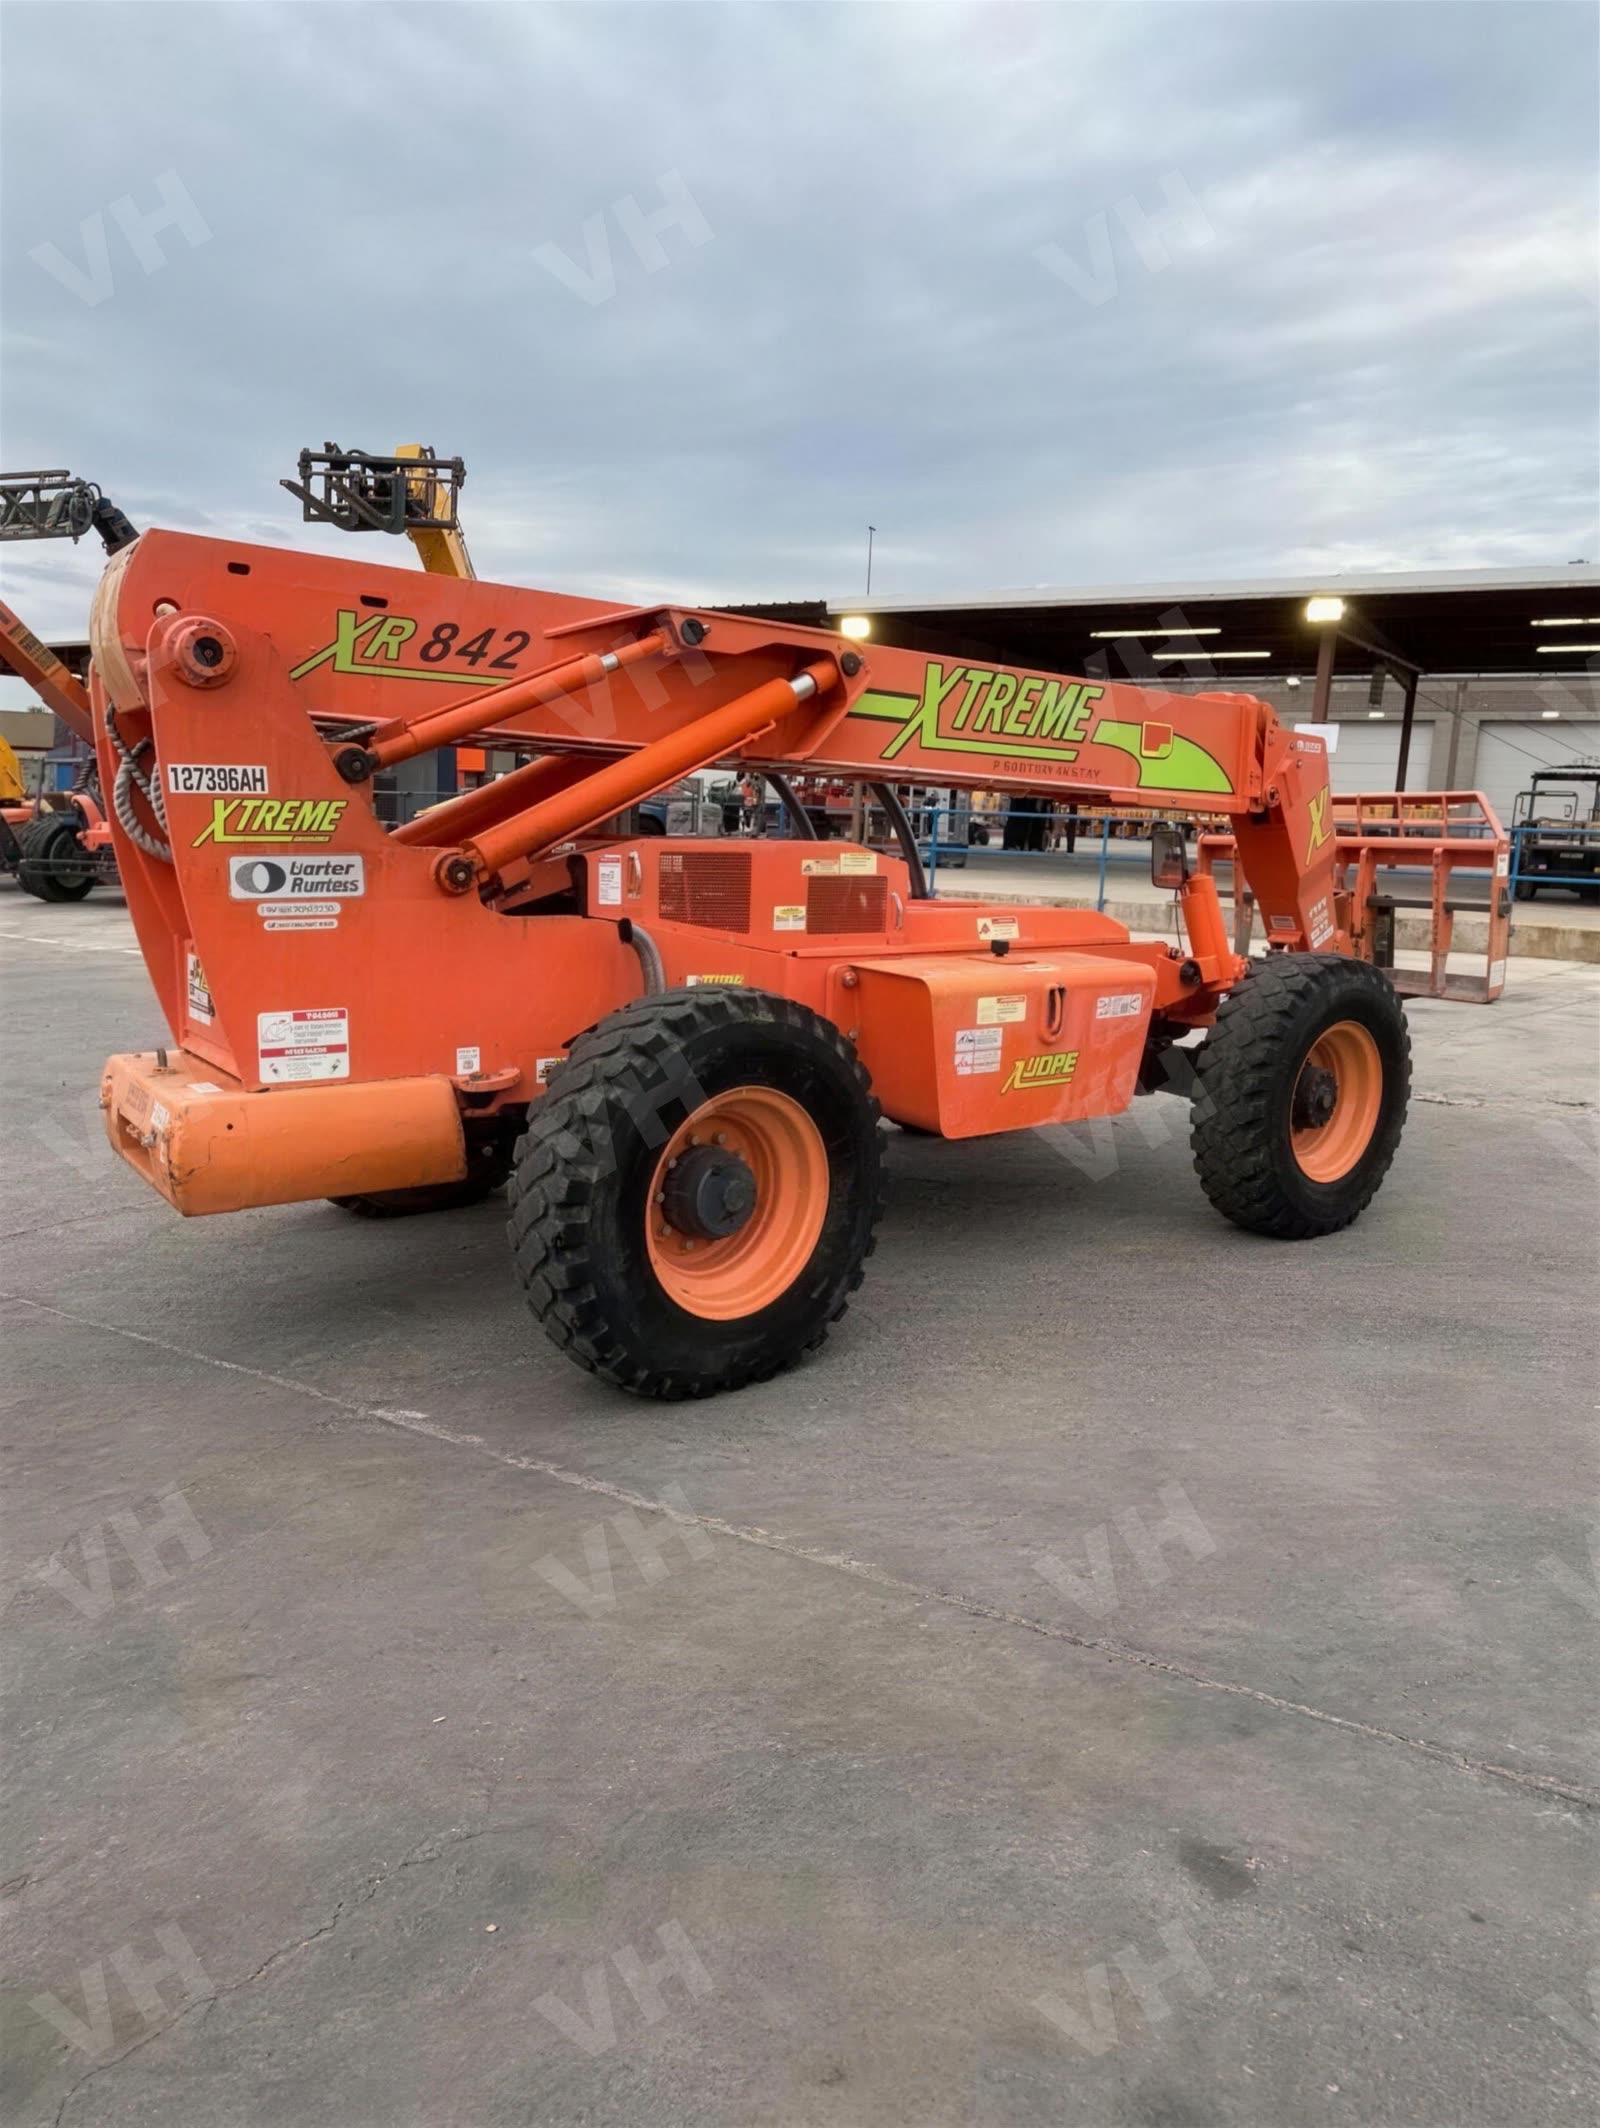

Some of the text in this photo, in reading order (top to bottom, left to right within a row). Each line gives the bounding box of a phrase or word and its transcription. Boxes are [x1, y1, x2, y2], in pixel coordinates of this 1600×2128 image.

[419, 622, 531, 670] 842
[879, 661, 1105, 762] XTREME
[170, 766, 266, 792] 127396AH
[191, 799, 348, 848] XTREME
